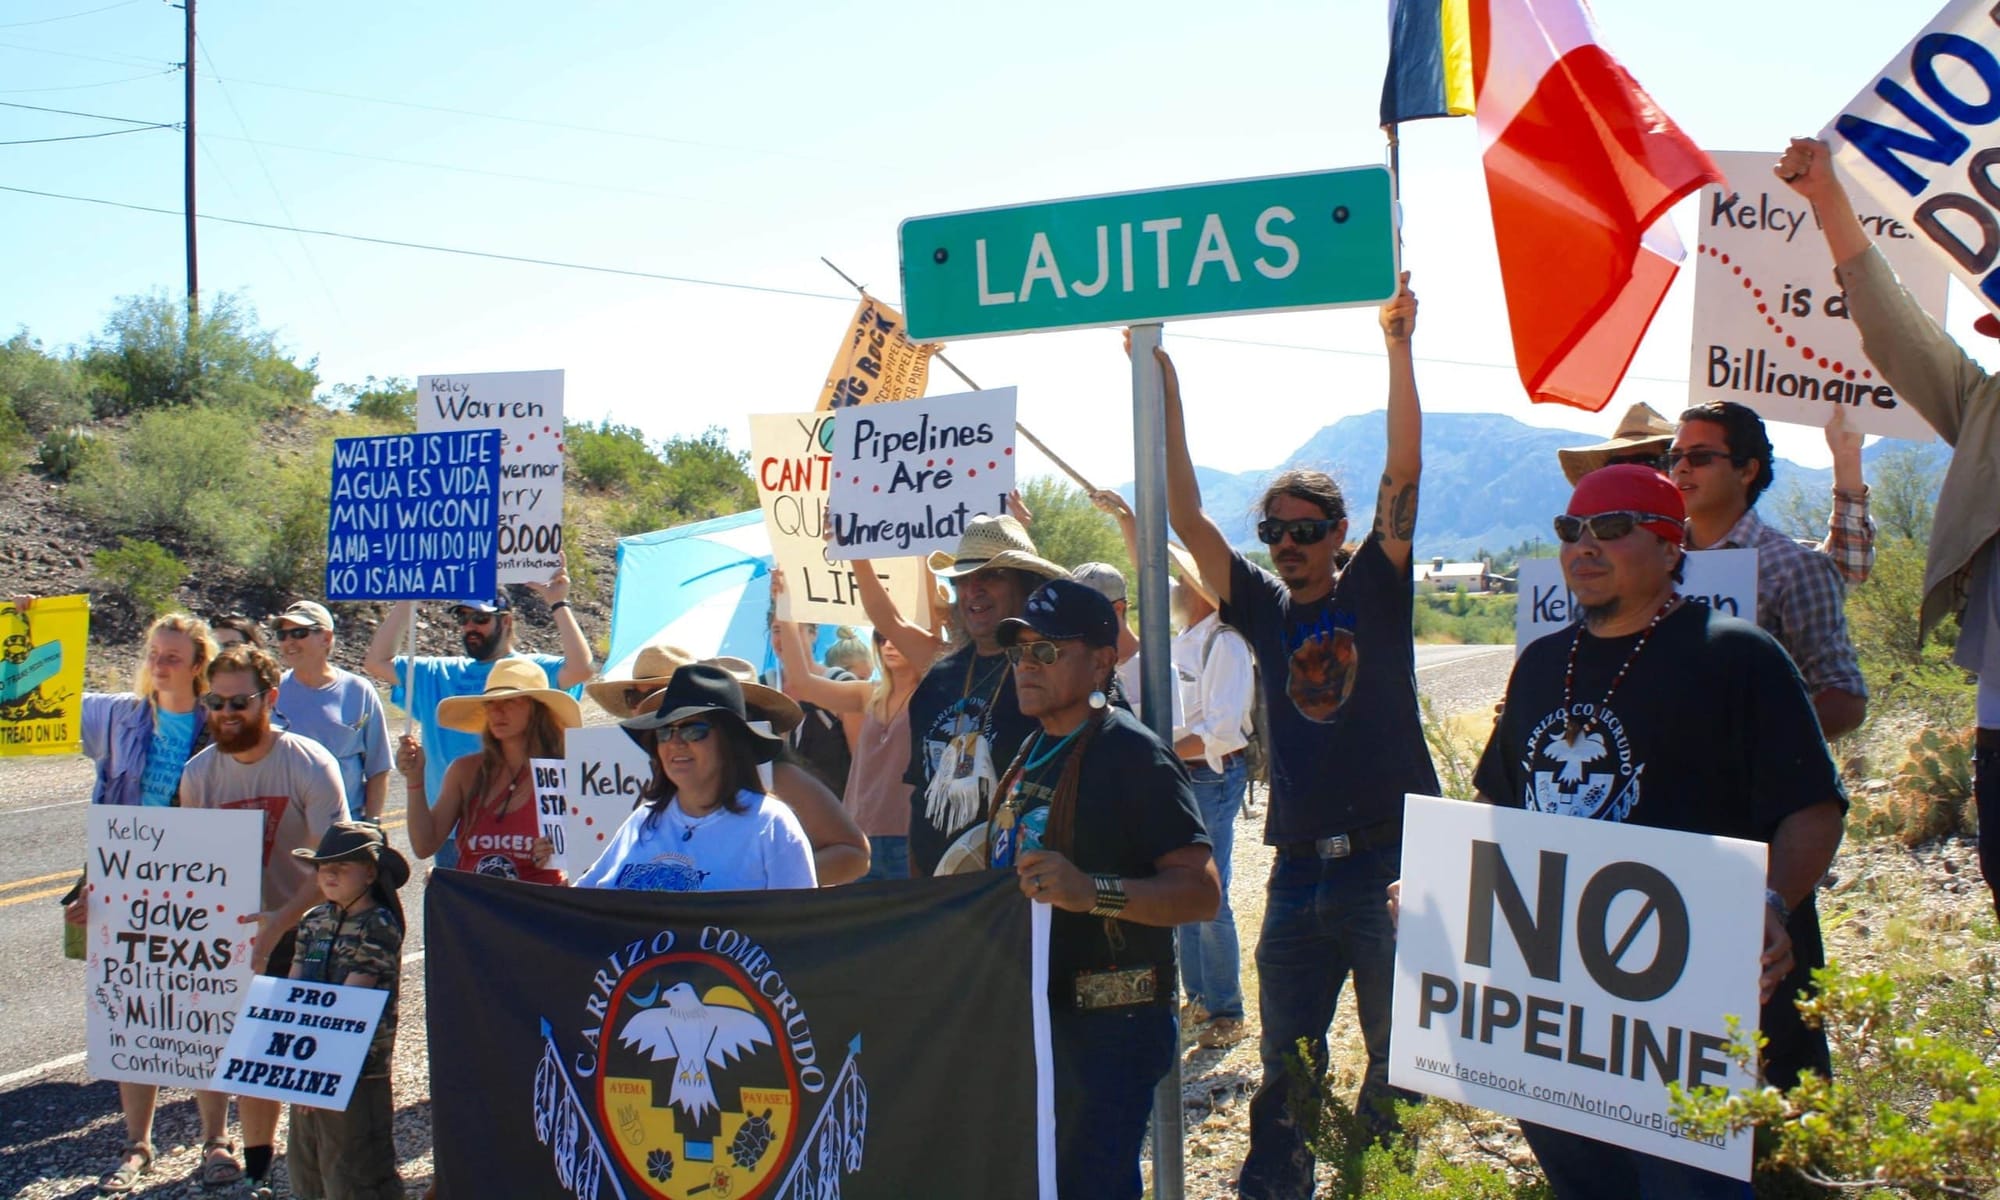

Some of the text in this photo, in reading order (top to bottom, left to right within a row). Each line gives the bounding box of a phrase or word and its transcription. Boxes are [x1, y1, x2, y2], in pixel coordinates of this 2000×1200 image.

[1711, 191, 1806, 242] Kelcy
[975, 205, 1300, 307] LAJITAS
[1780, 284, 1811, 318] is
[856, 311, 896, 379] ROCK
[887, 330, 907, 372] PIPELIN
[896, 341, 917, 385] PIPELI
[1708, 345, 1899, 410] Billionaire
[431, 378, 470, 397] Kelcy
[435, 395, 544, 422] Warren
[334, 432, 493, 469] WATER IS LIFE
[852, 413, 994, 463] Pipelines
[334, 465, 491, 500] AGUA ES VIDA
[500, 463, 559, 479] vernor
[760, 454, 833, 492] CAN'T
[887, 461, 953, 494] Are
[331, 498, 489, 531] MNI WICONI
[502, 488, 543, 510] rry
[833, 493, 1007, 549] Unregulat
[499, 523, 562, 555] 0,000
[330, 564, 359, 594] KÓ
[497, 558, 562, 570] ontributions
[1532, 584, 1573, 623] Kel
[0, 723, 68, 744] TREAD ON US
[535, 767, 560, 789] BIG
[540, 794, 567, 816] STA
[107, 818, 165, 852] Kelcy
[468, 835, 533, 851] VOICES
[98, 847, 227, 886] Warren
[129, 899, 209, 931] gave
[116, 932, 233, 972] TEXAS
[103, 957, 238, 995] Politicians
[125, 992, 238, 1034] Millions
[286, 986, 337, 1008] PRO
[576, 925, 826, 1094] CARRIZO COMECRUDO
[246, 1006, 368, 1034] LAND RIGHTS
[1418, 971, 1731, 1097] PIPELINE
[110, 1028, 126, 1047] in
[265, 1032, 317, 1061] NO
[223, 1058, 342, 1097] PIPELINE
[609, 1082, 647, 1096] AYEMA
